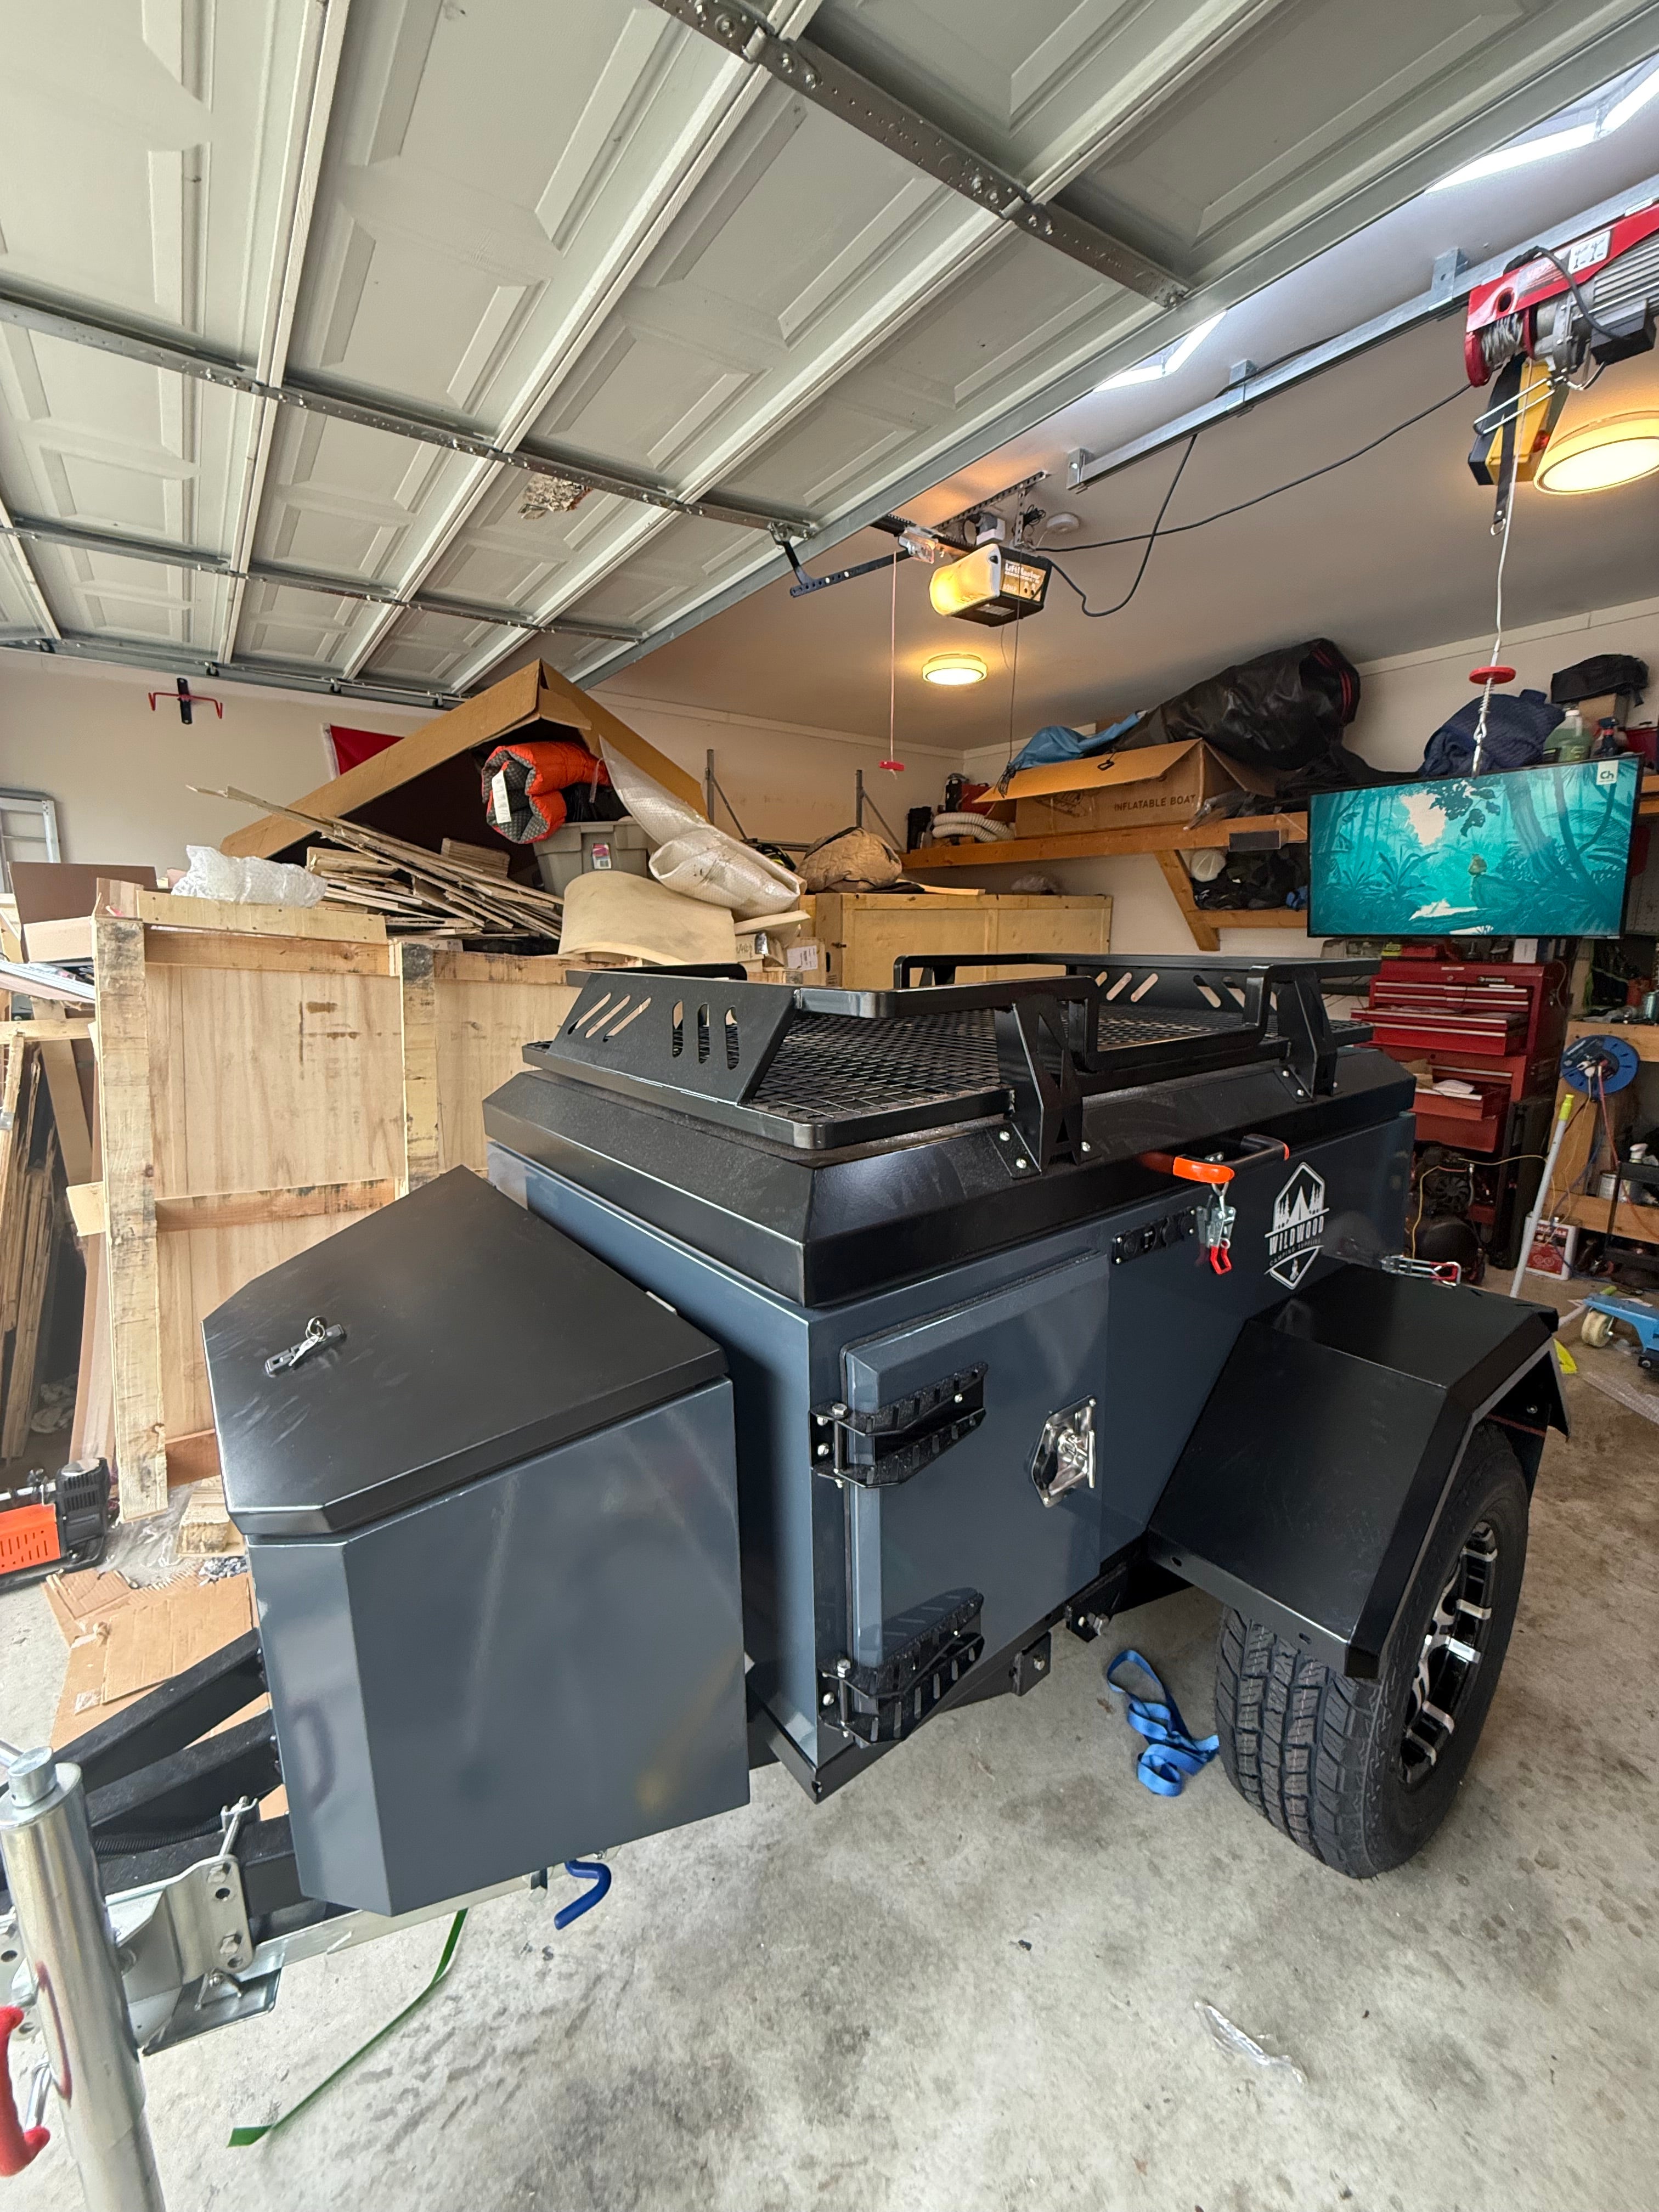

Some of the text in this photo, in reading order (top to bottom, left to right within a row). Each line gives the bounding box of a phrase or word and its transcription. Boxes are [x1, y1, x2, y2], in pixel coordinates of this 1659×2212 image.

[1114, 794, 1196, 811] INFLATABLE BOAT
[1269, 1215, 1324, 1256] WILDWOOD
[1269, 1246, 1295, 1267] CAMPING
